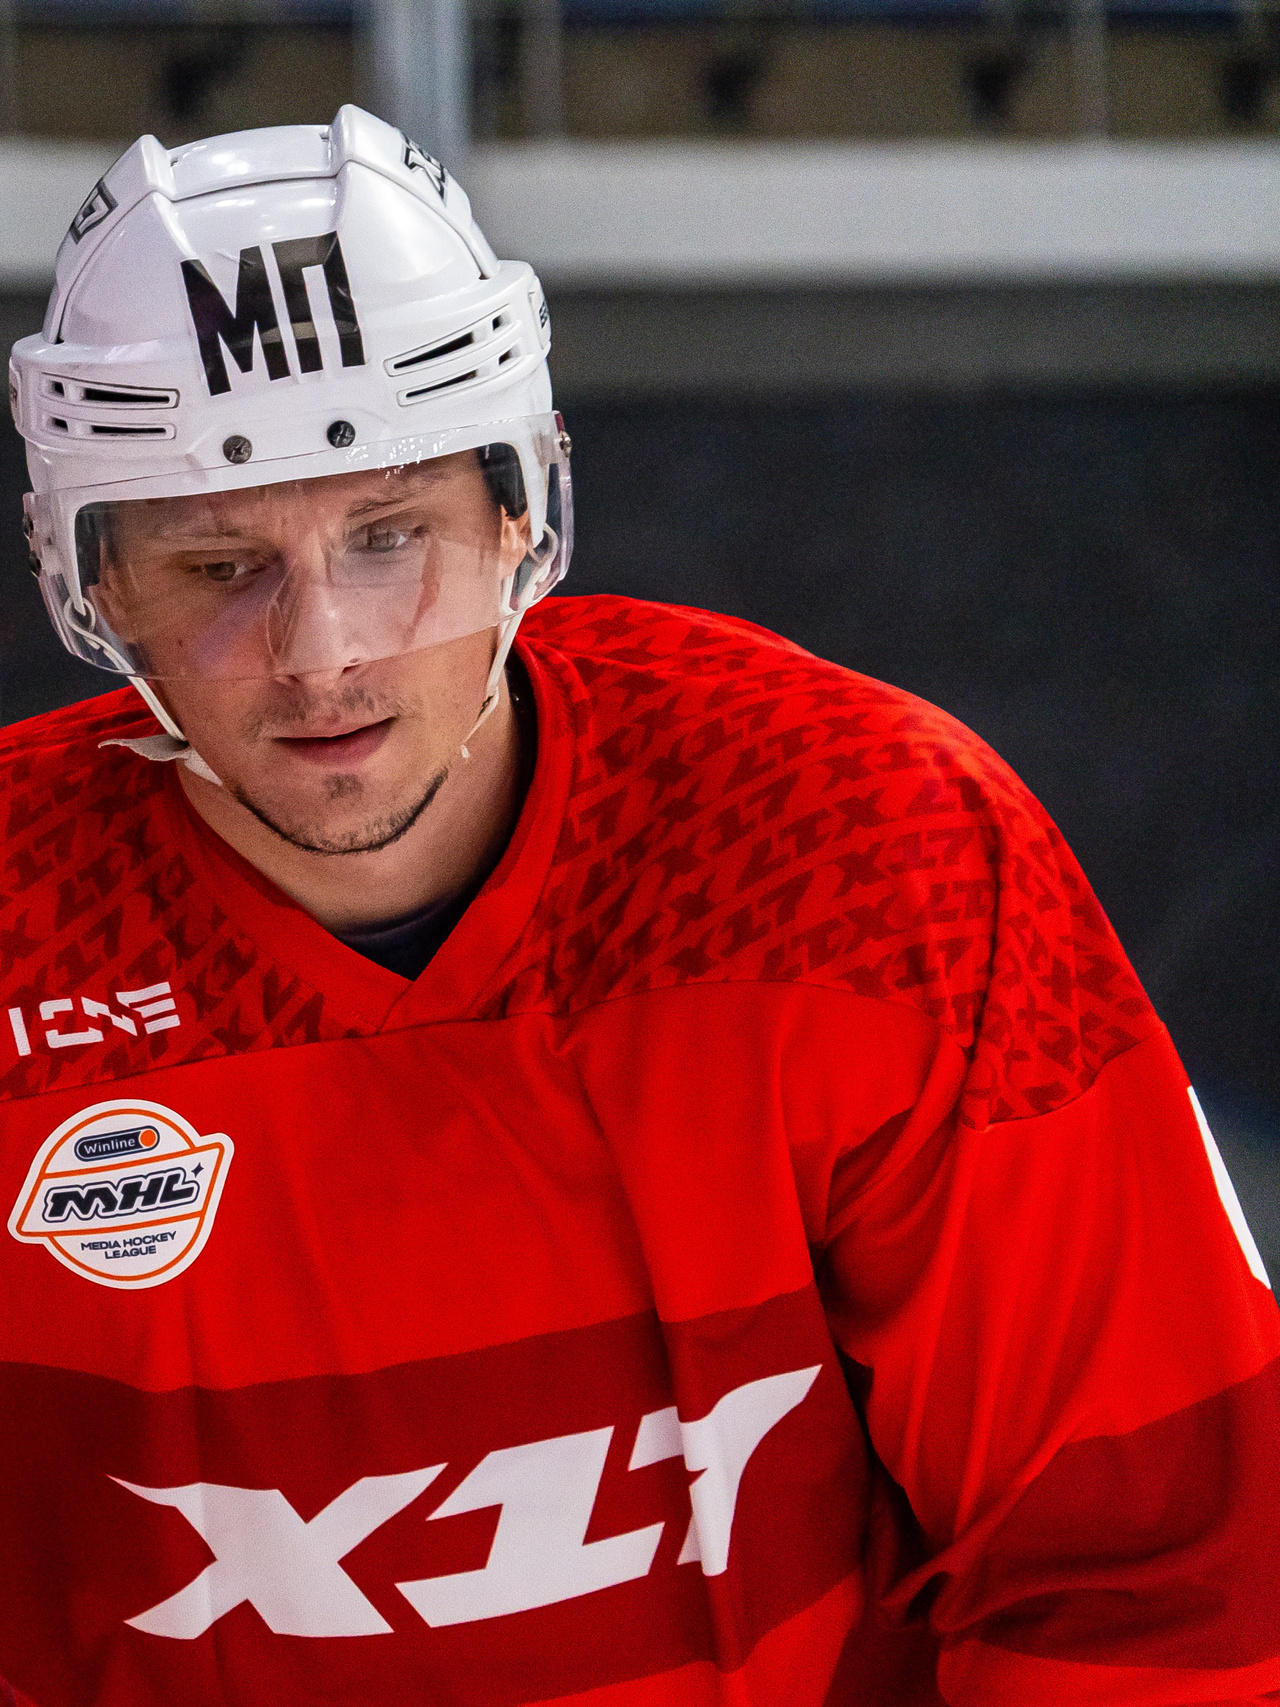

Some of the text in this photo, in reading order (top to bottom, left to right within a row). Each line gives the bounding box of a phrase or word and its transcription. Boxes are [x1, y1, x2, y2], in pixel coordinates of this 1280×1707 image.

[180, 230, 366, 396] МП
[83, 1137, 136, 1155] Winline
[46, 1172, 196, 1219] MHL
[80, 1230, 177, 1251] MEDIA HOCKEY
[104, 1244, 157, 1260] LEAGUE
[106, 1365, 822, 1640] X17
